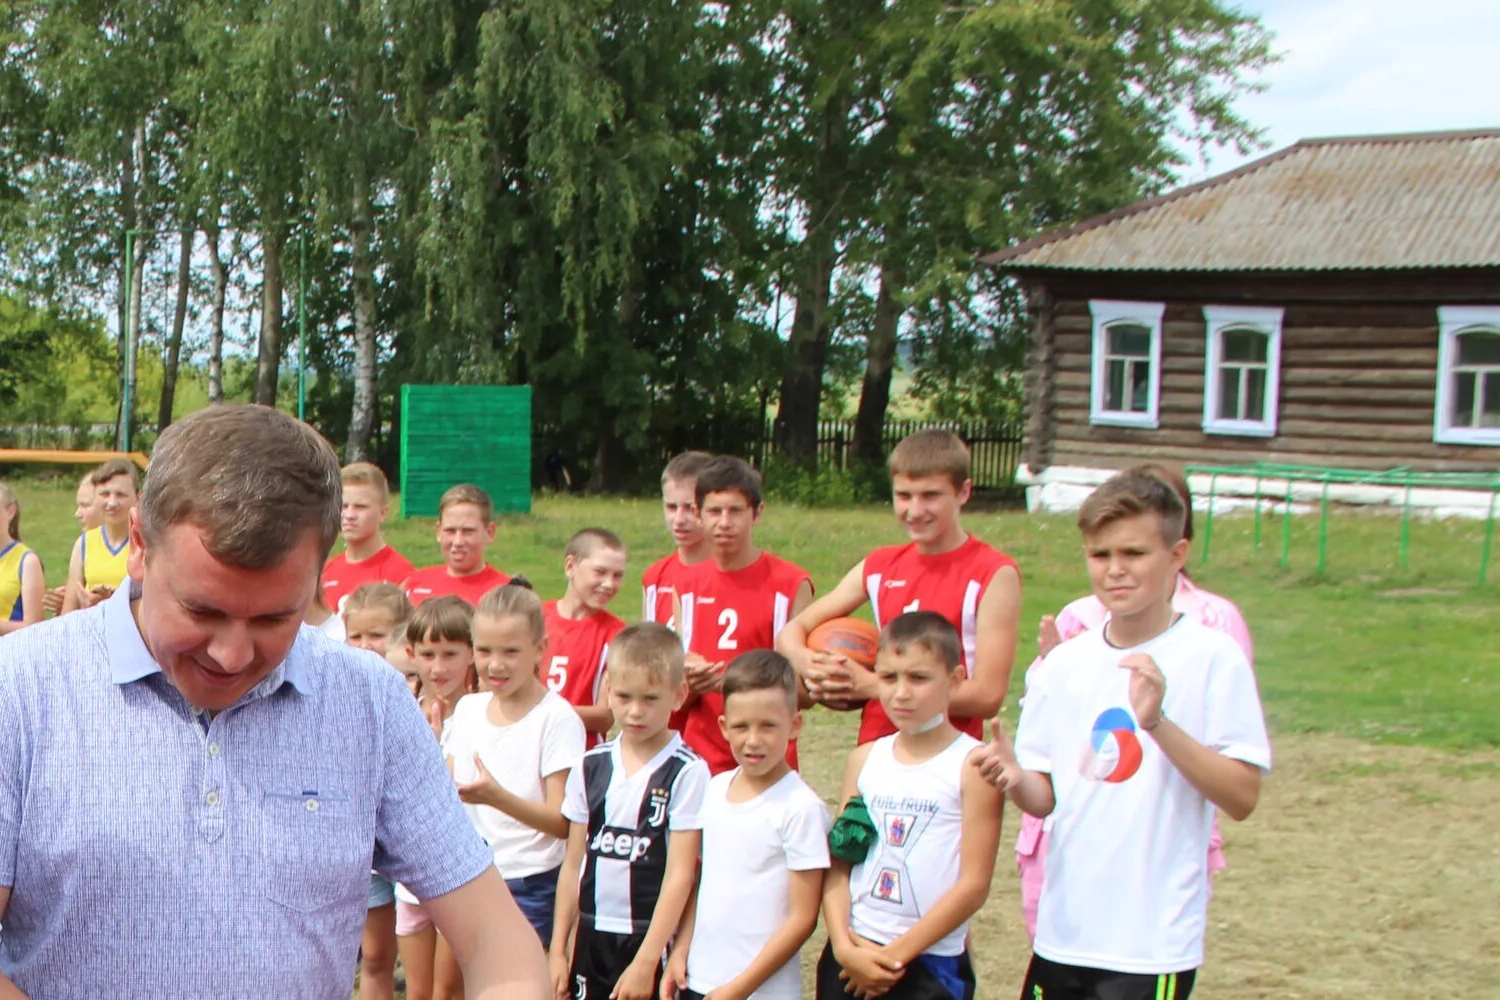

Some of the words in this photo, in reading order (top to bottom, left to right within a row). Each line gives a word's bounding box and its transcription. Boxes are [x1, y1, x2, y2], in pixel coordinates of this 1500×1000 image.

[717, 607, 739, 650] 2
[546, 655, 569, 692] 5
[590, 824, 652, 862] Jeep
